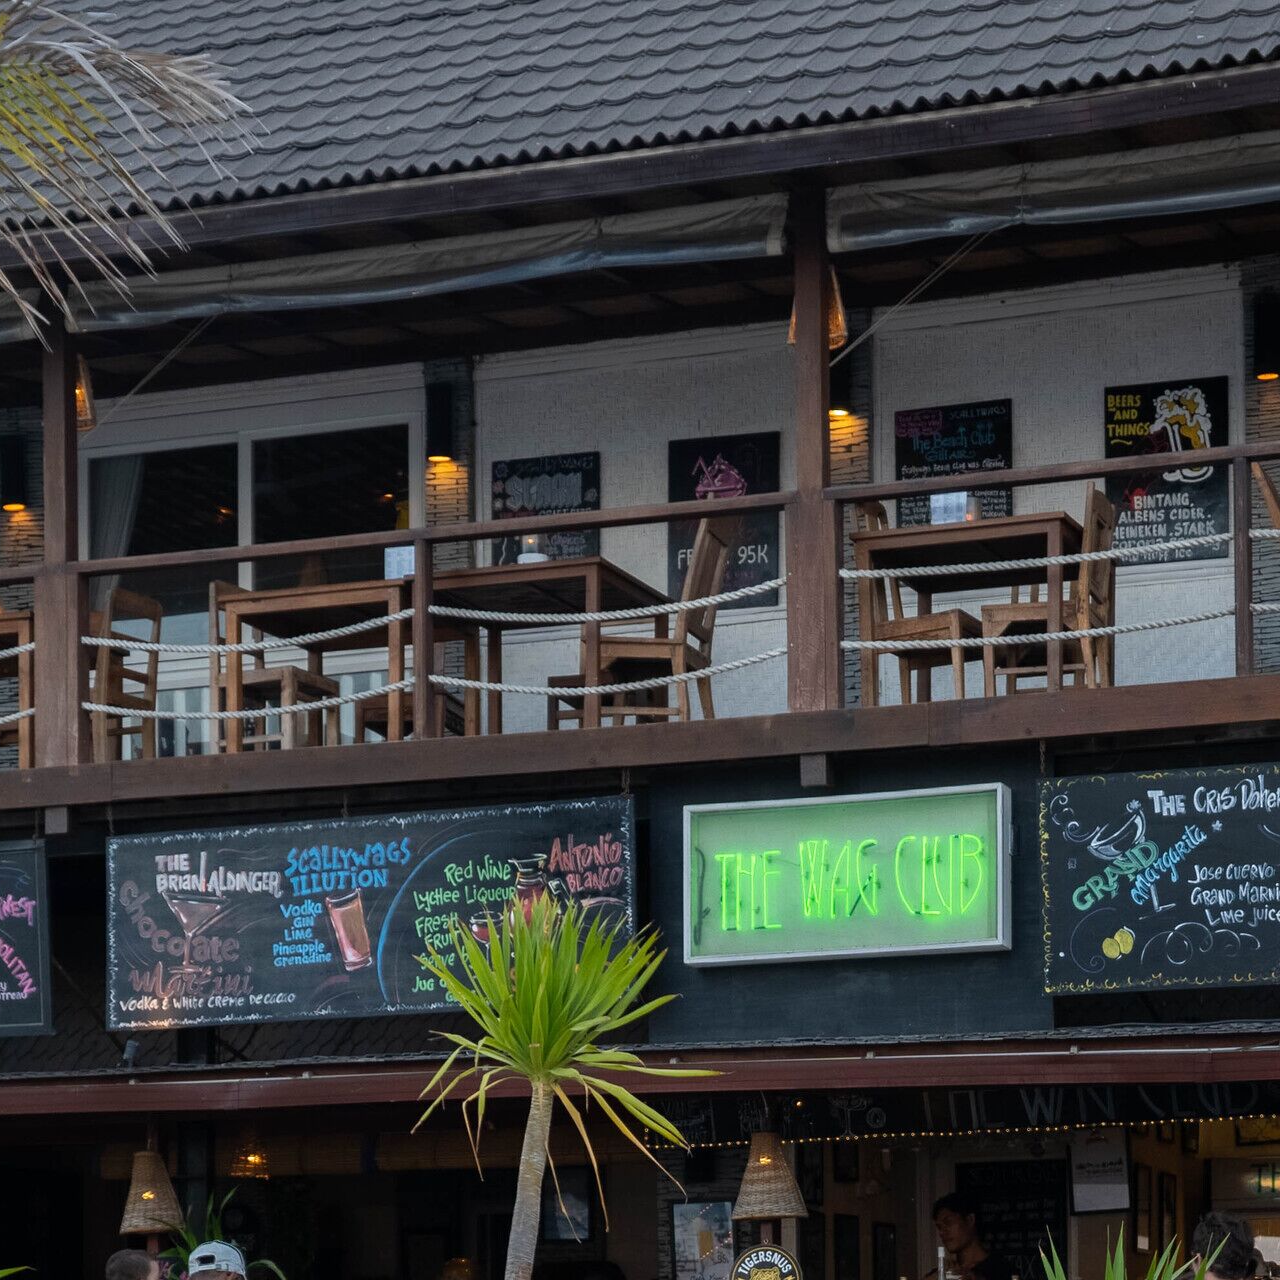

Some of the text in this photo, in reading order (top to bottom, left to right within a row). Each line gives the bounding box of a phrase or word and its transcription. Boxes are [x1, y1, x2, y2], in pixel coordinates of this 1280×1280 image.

[1106, 394, 1141, 408] BEERS
[1113, 409, 1138, 420] AND
[1107, 421, 1151, 437] THINGS
[1119, 510, 1165, 523] ALBENS
[738, 543, 768, 566] 95K
[1147, 789, 1187, 816] THE
[1193, 786, 1238, 814] CRIS
[155, 853, 190, 872] THE
[283, 836, 412, 878] SCALLYWAGS
[443, 854, 512, 886] Red WiNe
[1072, 840, 1160, 911] GRAND
[1188, 864, 1224, 884] Jose
[155, 866, 284, 899] BRIAN ALDINGER
[289, 865, 390, 897] ILLUTION
[565, 869, 626, 893] BLANCO
[714, 834, 984, 931] THE WAG CLUB
[1190, 885, 1236, 906] GRAND
[280, 899, 323, 919] Vodka
[1205, 904, 1245, 926] Lime
[293, 916, 314, 928] GIN
[284, 927, 313, 941] Lime
[273, 939, 326, 956] Pineapple
[273, 951, 332, 968] Grenadine
[412, 975, 435, 993] JUG
[119, 995, 158, 1012] Vodka
[737, 1250, 793, 1275] TIGERSNUS
